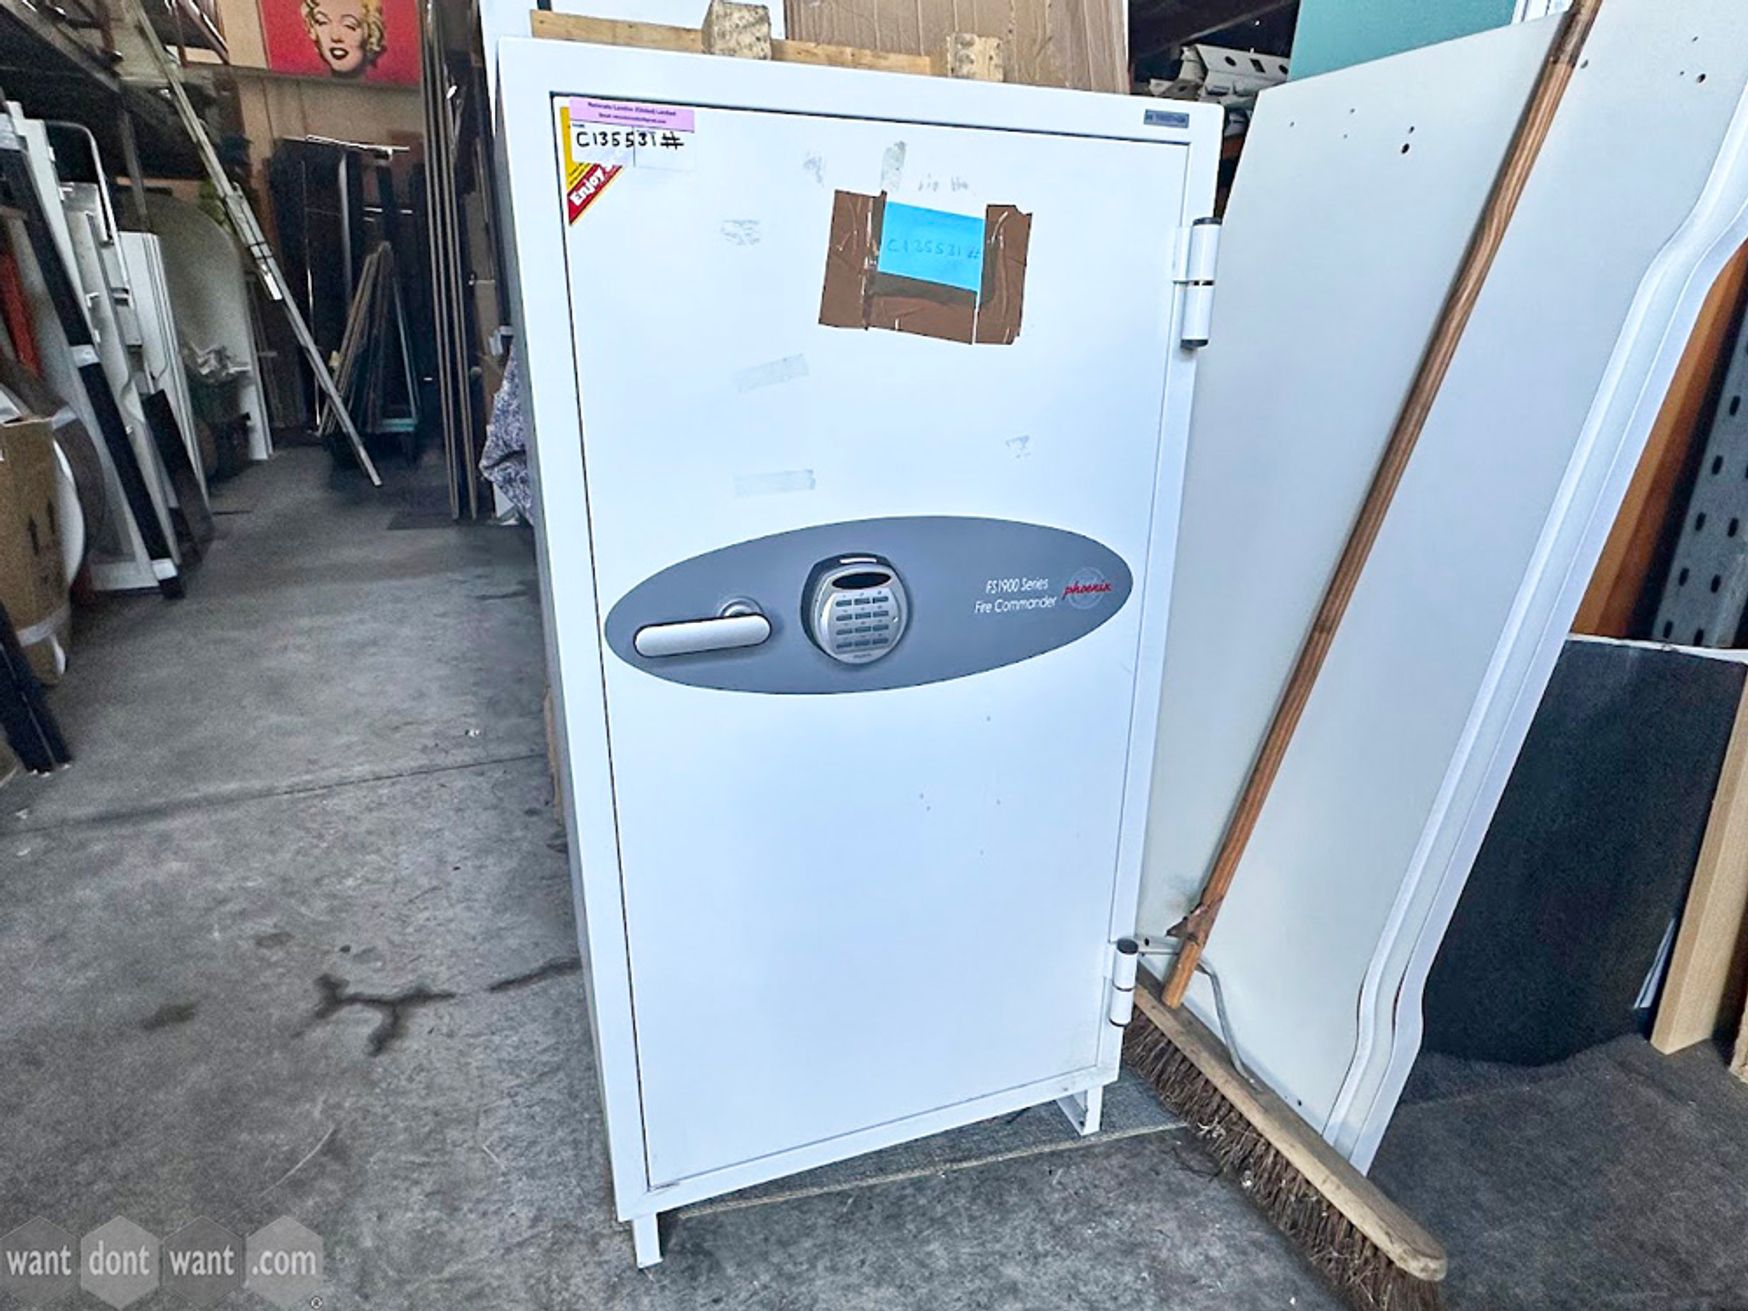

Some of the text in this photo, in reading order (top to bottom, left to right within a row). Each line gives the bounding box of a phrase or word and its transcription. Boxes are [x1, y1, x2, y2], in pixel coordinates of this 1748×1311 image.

[569, 166, 606, 206] Enjoy
[985, 577, 1049, 594] FS1900 Series
[1062, 579, 1113, 600] phoenix
[974, 596, 1058, 614] Fire Commander
